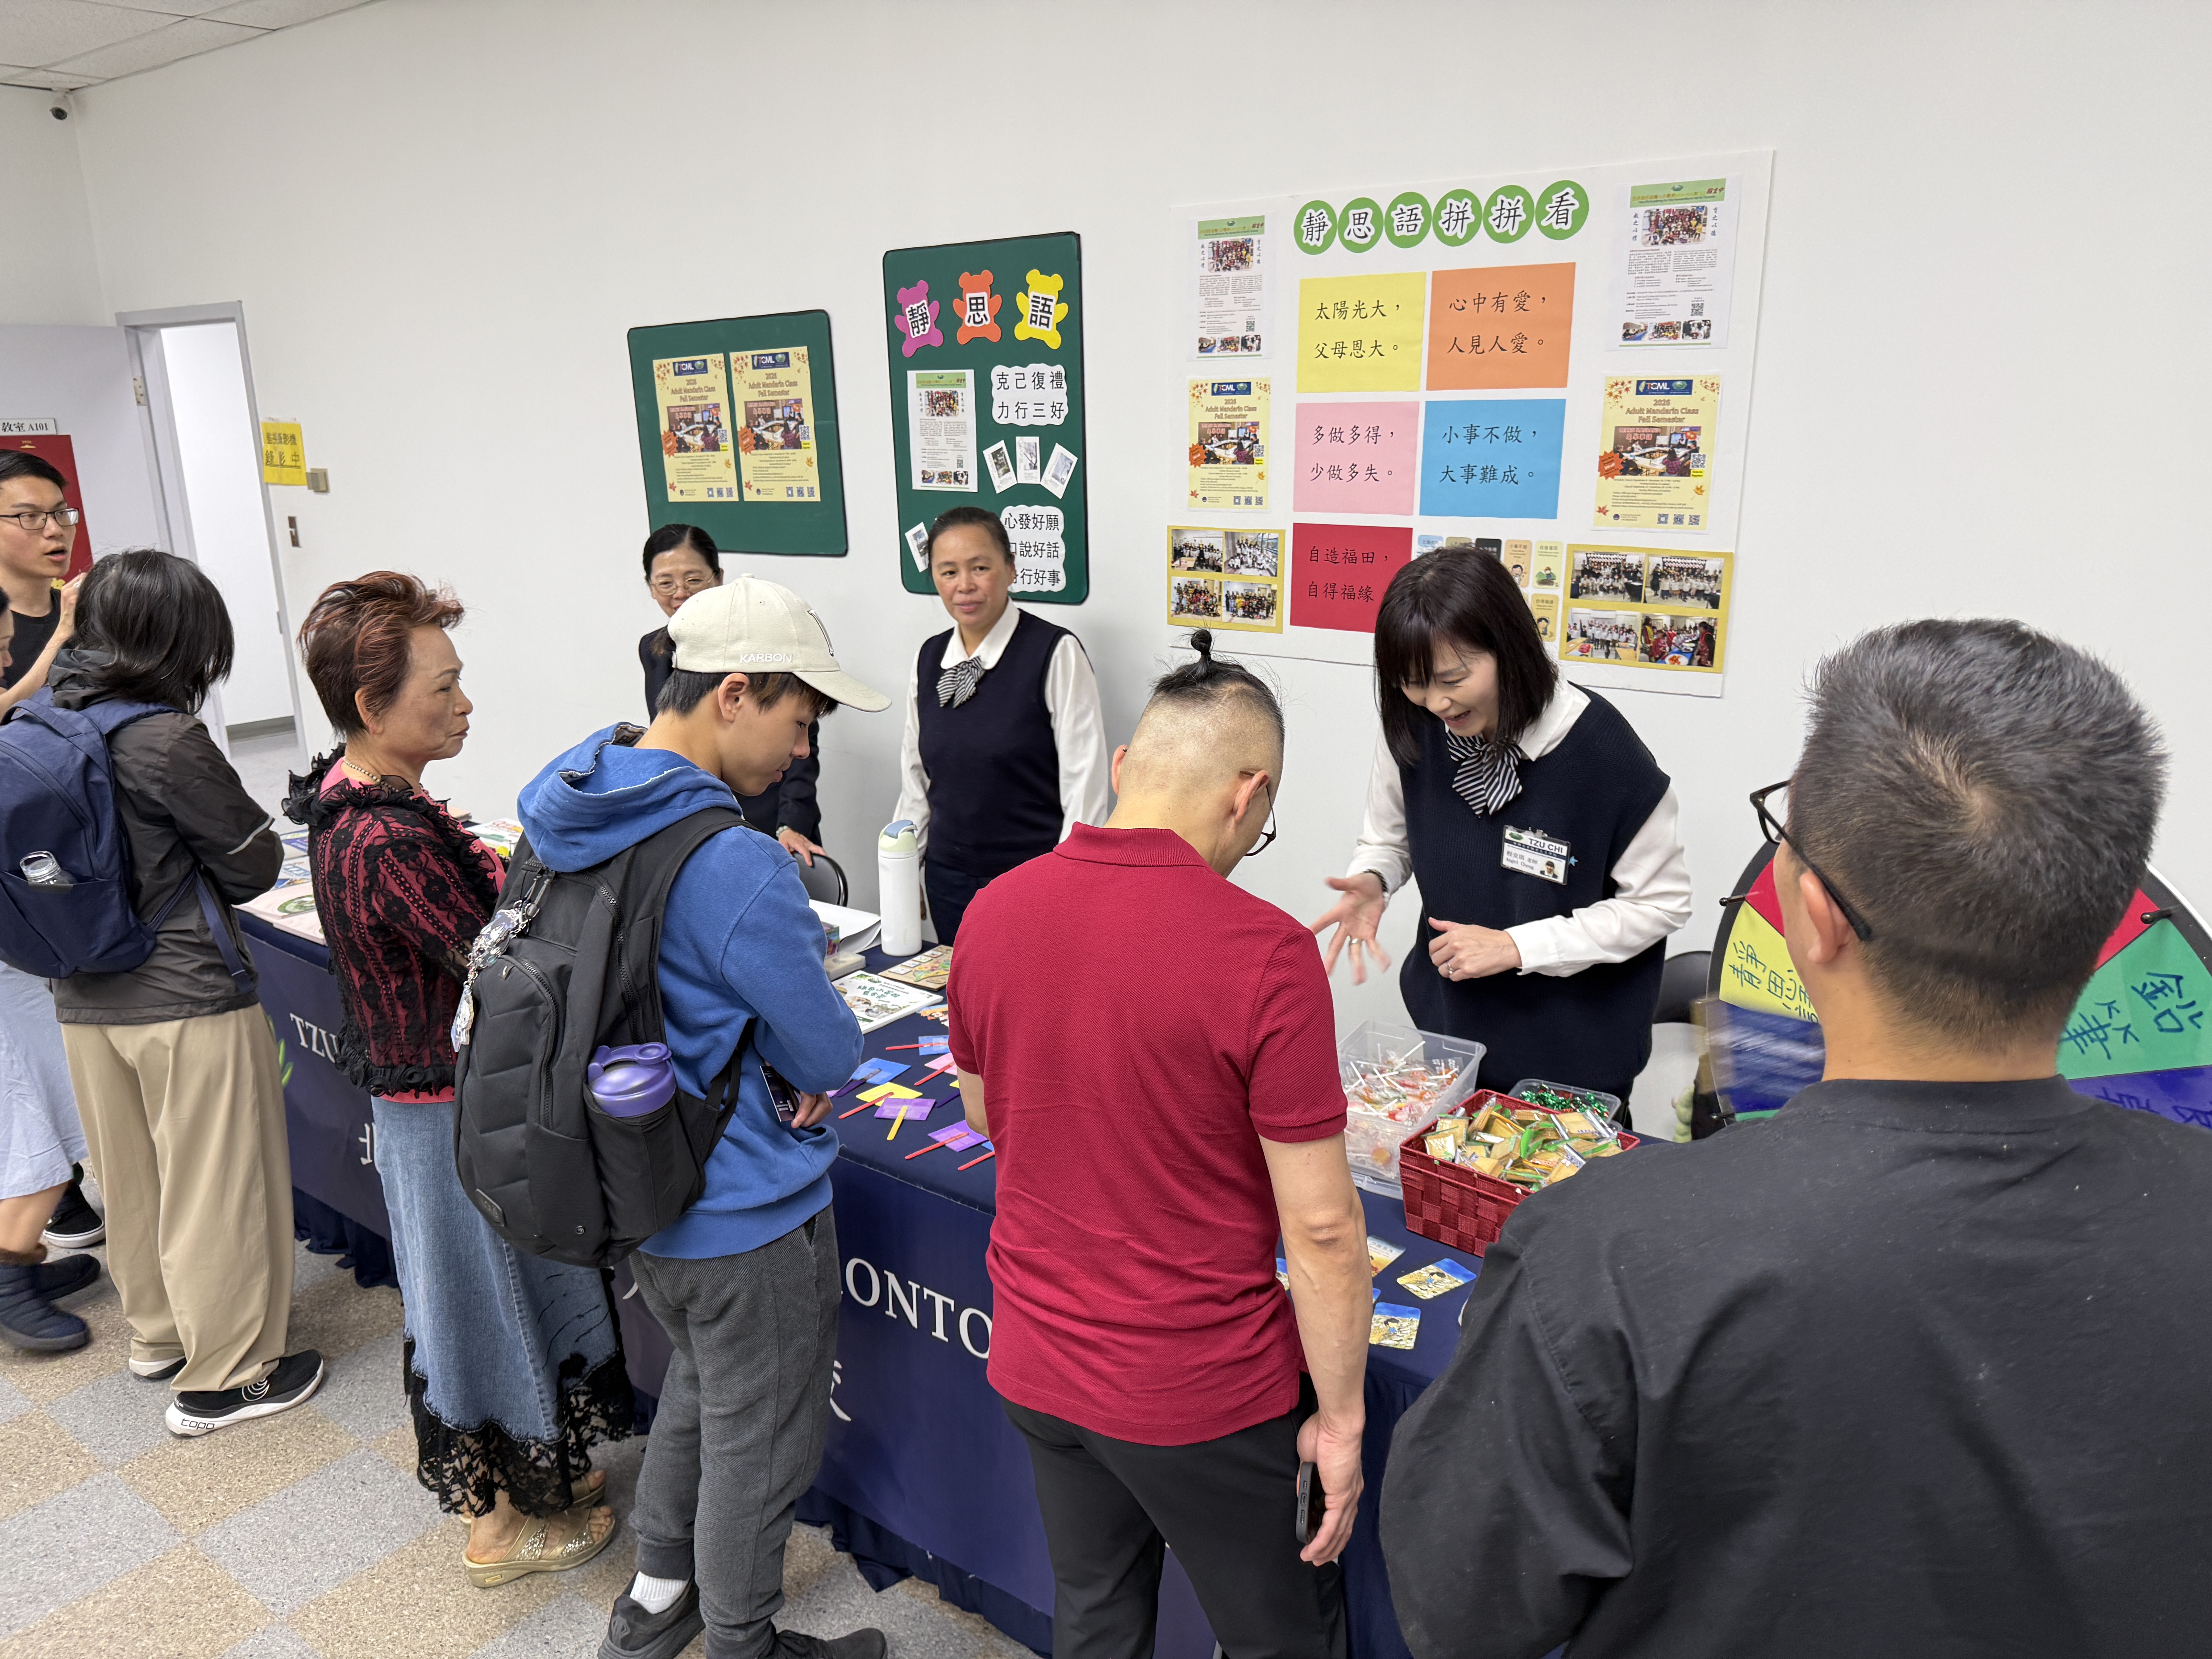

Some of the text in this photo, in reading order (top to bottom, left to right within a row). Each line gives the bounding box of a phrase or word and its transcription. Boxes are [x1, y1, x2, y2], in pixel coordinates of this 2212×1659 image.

[1302, 191, 1576, 243] 靜思語拼拼看
[1315, 300, 1400, 320] 太陽光大，
[1449, 290, 1546, 313] 心中有愛，
[907, 295, 1054, 336] 靜思語
[1315, 340, 1398, 359] 父母恩大。
[1447, 332, 1543, 354] 人見人愛。
[996, 370, 1065, 390] 克己復禮
[1646, 382, 1670, 390] TCML
[997, 401, 1065, 420] 力行三好
[2, 422, 48, 433] 教室 A101
[1313, 425, 1393, 445] 多做多得，
[1443, 424, 1537, 445] 小事不做，
[1311, 463, 1392, 483] 少做多失。
[1439, 464, 1534, 485] 大事難成。
[1005, 512, 1060, 531] 心發好願
[1310, 546, 1388, 565] 自造福田，
[1013, 568, 1060, 586] 行好事
[740, 653, 793, 663] KARBON
[1528, 838, 1546, 848] TZU
[1548, 844, 1563, 854] CHI
[290, 1012, 338, 1063] TZU
[841, 1257, 993, 1360] ONTO
[181, 1418, 215, 1430] topo
